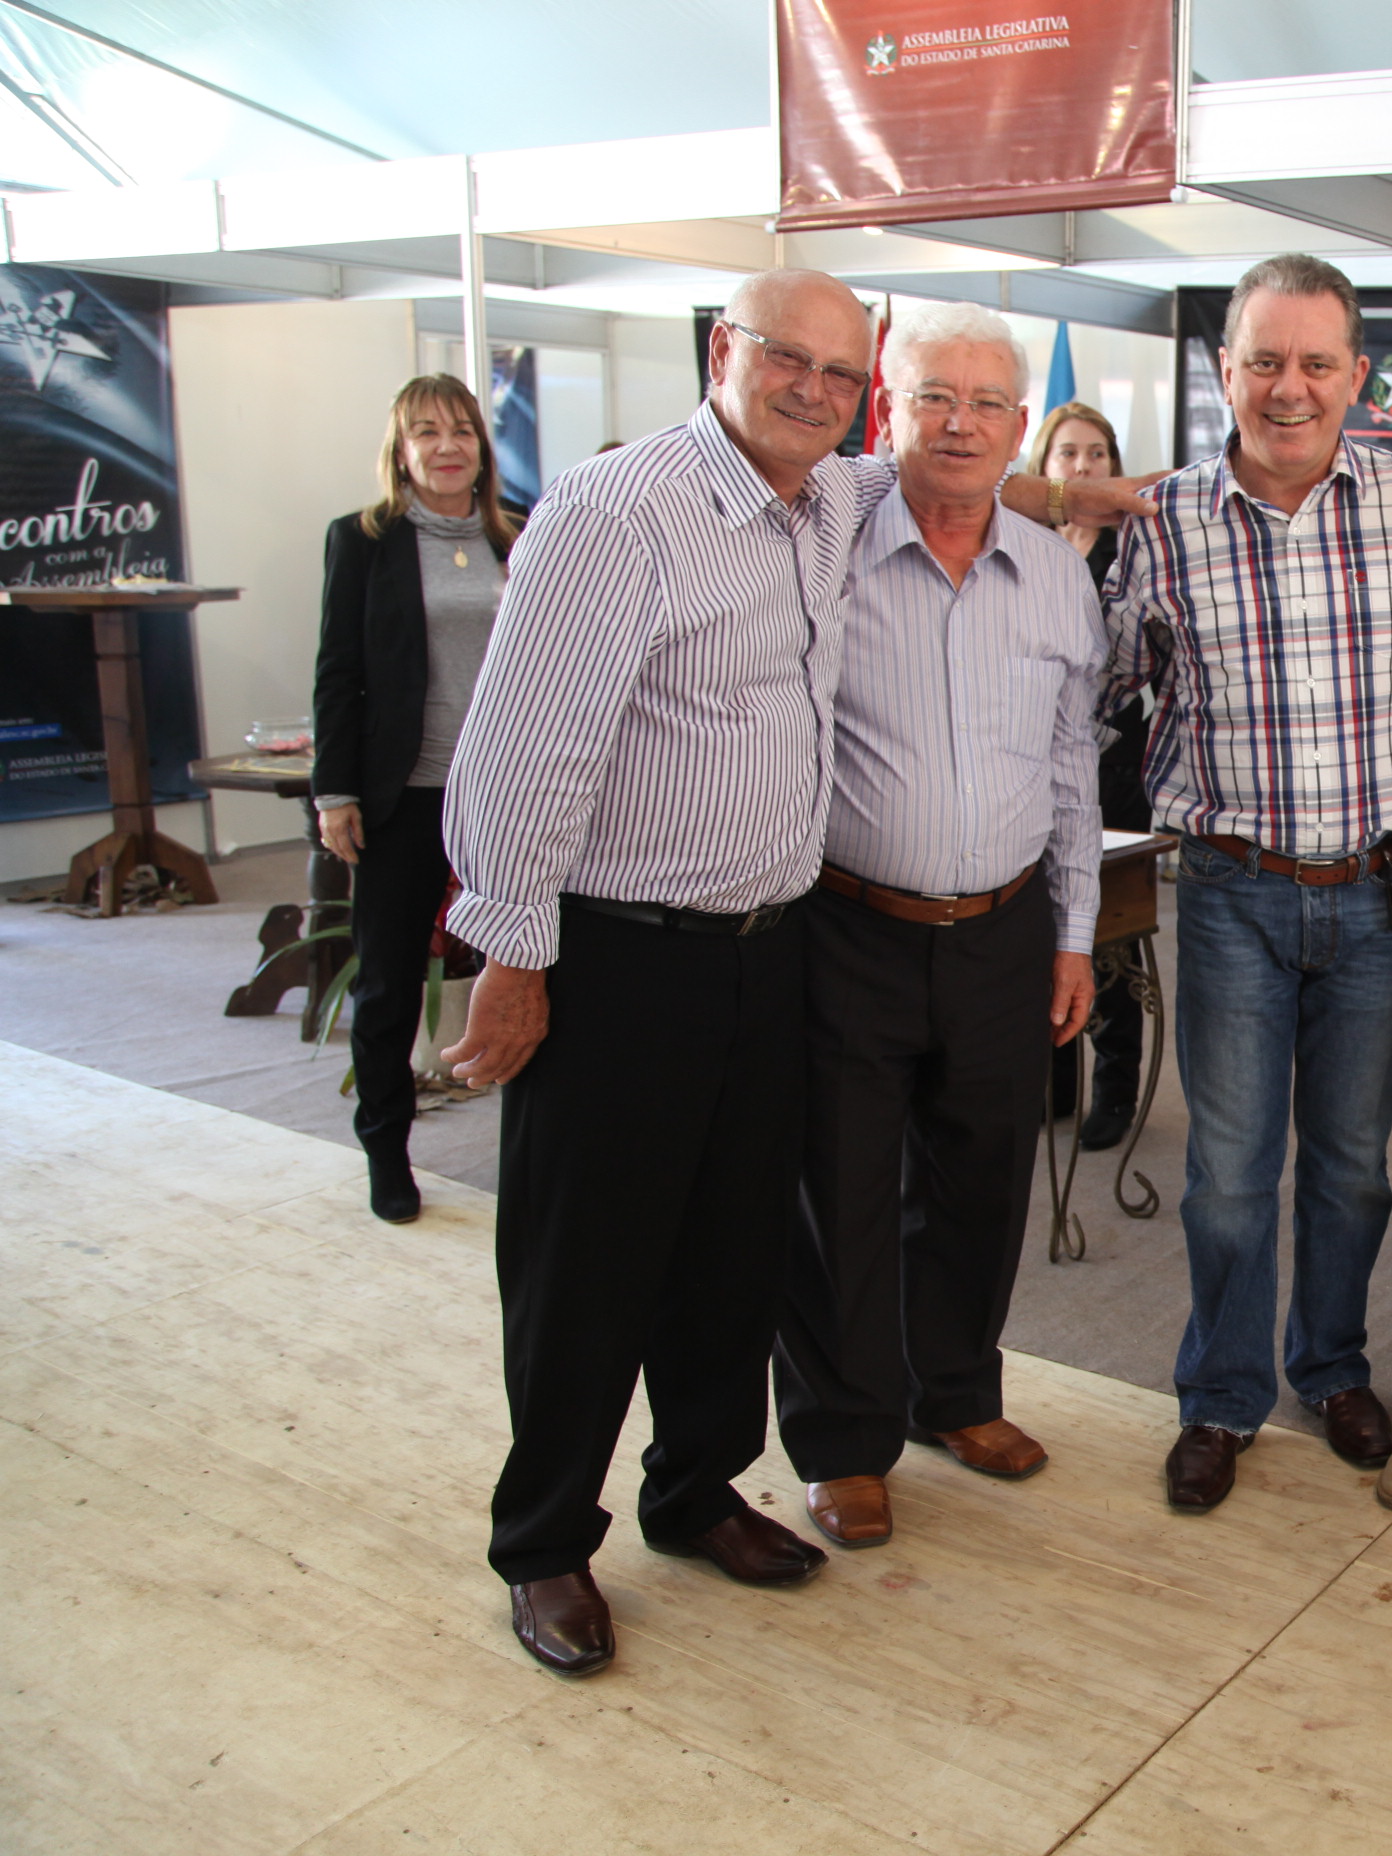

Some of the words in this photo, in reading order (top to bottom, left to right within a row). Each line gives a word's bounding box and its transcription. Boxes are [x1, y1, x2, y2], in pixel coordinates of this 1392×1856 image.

[902, 27, 982, 49] ASSEMBLEIA
[985, 16, 1069, 40] LEGISLATIVA
[901, 54, 918, 67] DO
[920, 49, 961, 64] ESTADO
[963, 47, 978, 60] DE
[980, 43, 1013, 58] SANTA
[1015, 36, 1070, 53] CATARINA
[0, 457, 160, 550] contros
[45, 549, 88, 566] com
[94, 546, 107, 558] a
